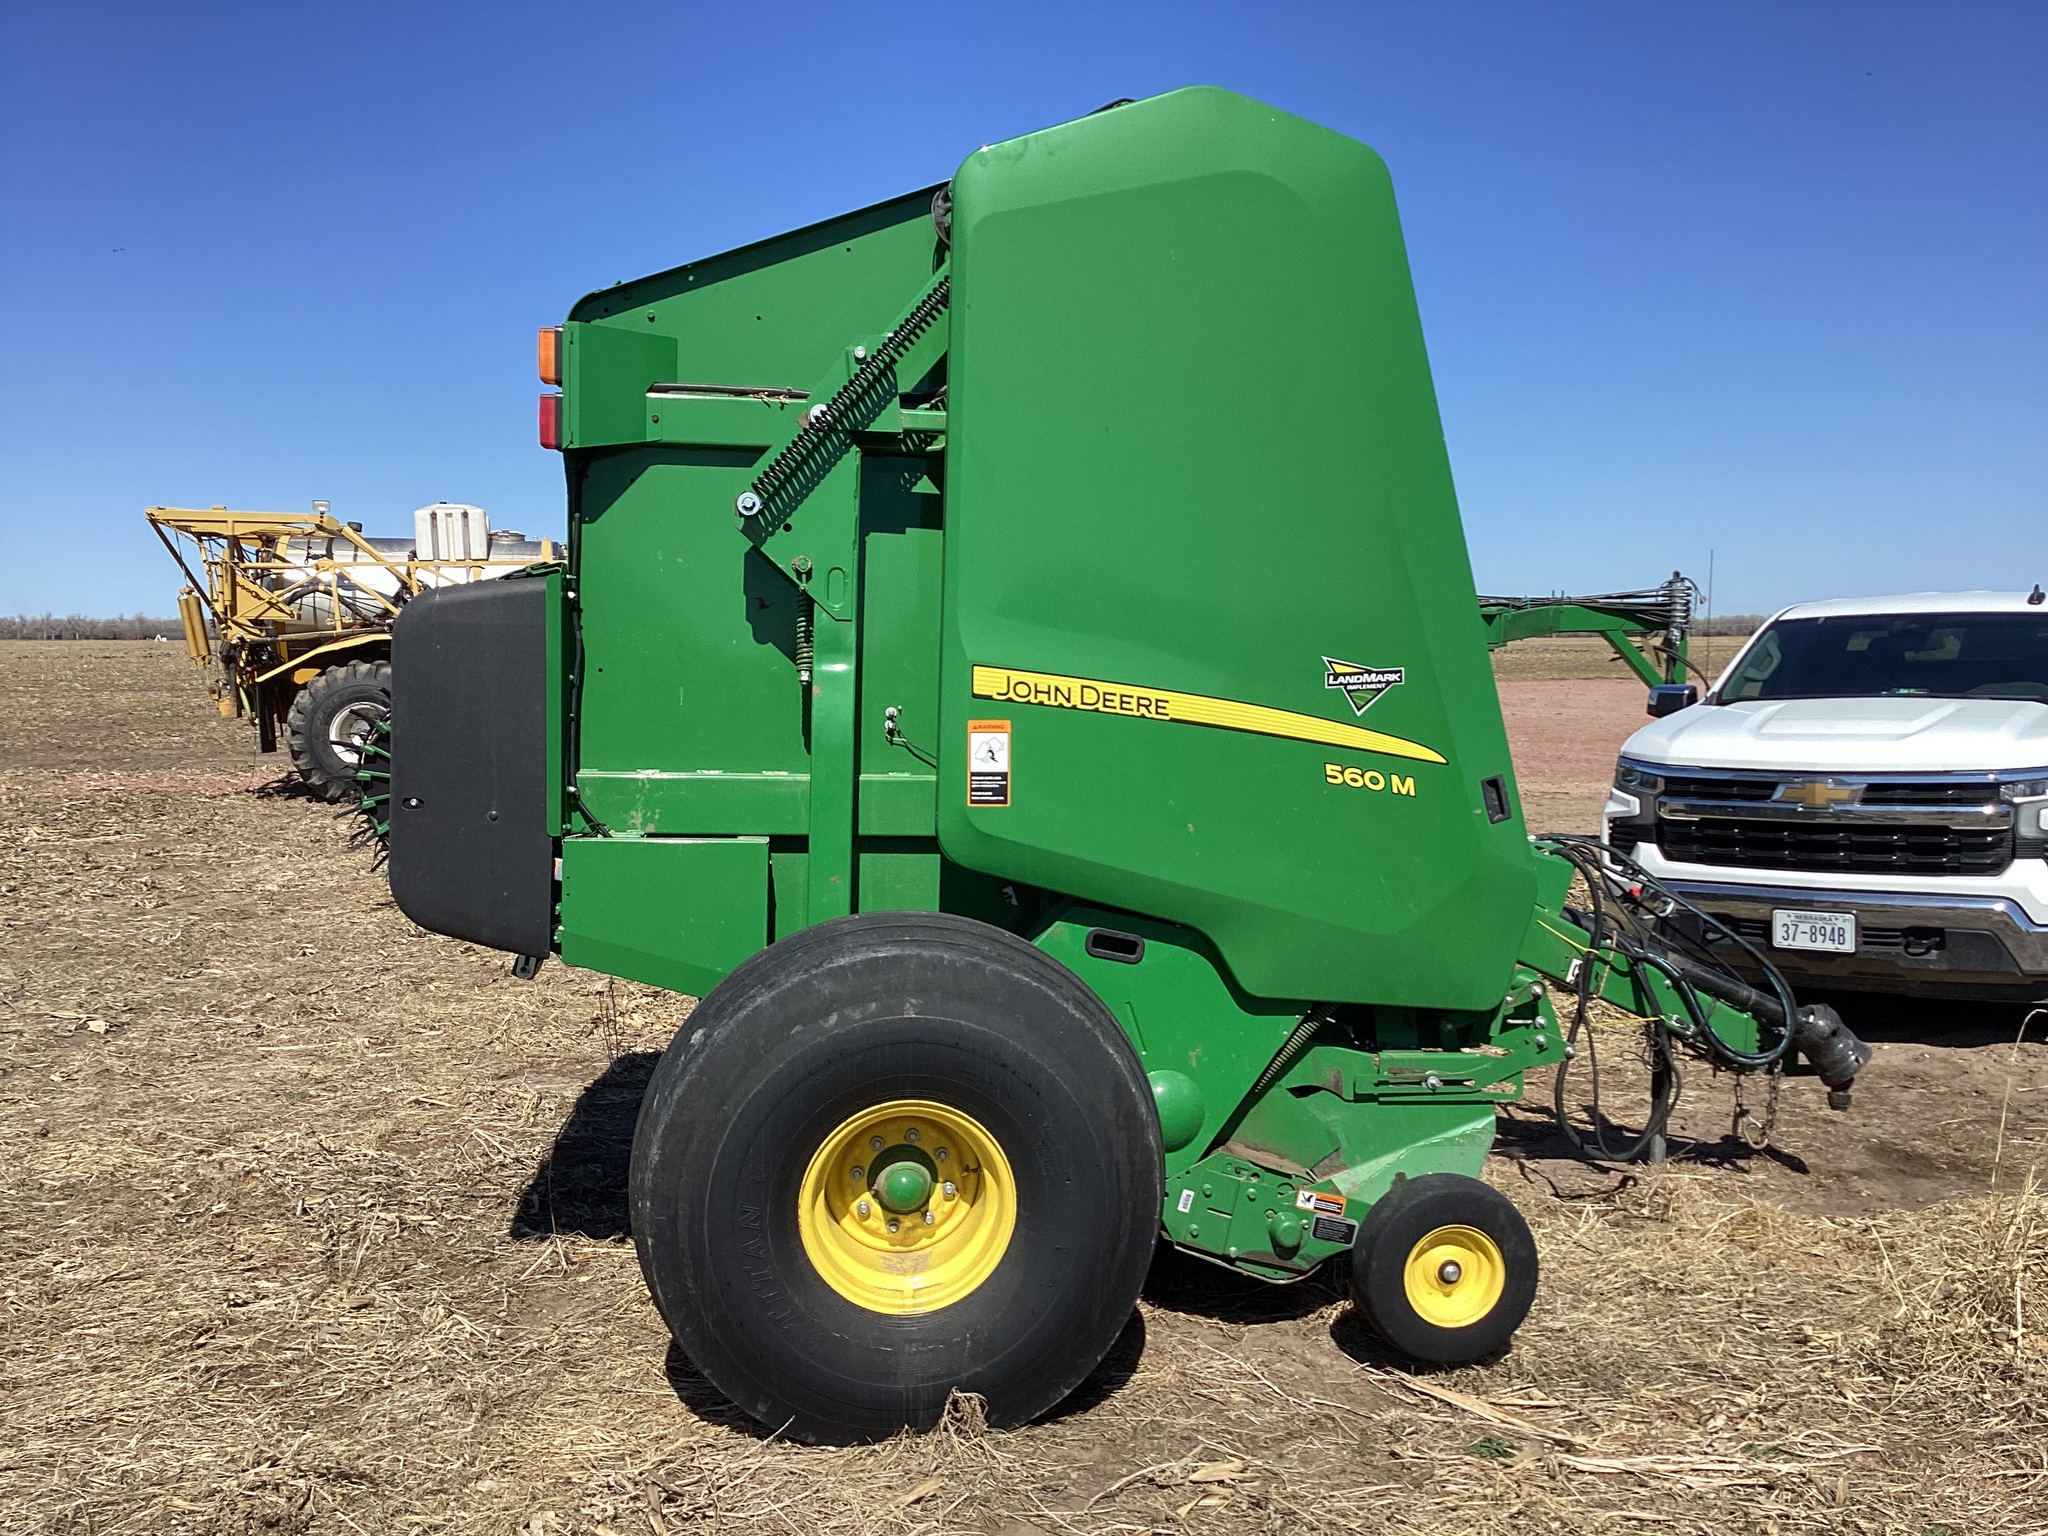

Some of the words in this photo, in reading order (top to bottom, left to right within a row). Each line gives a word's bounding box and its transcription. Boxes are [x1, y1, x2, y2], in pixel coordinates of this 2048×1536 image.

[1328, 672, 1401, 685] LANDMARK
[1346, 683, 1387, 691] IMPLEMENT
[996, 675, 1071, 704] JOHN
[1080, 684, 1170, 717] DEERE
[1324, 762, 1386, 792] 560
[1390, 772, 1417, 798] M
[1781, 923, 1846, 946] 37-894B
